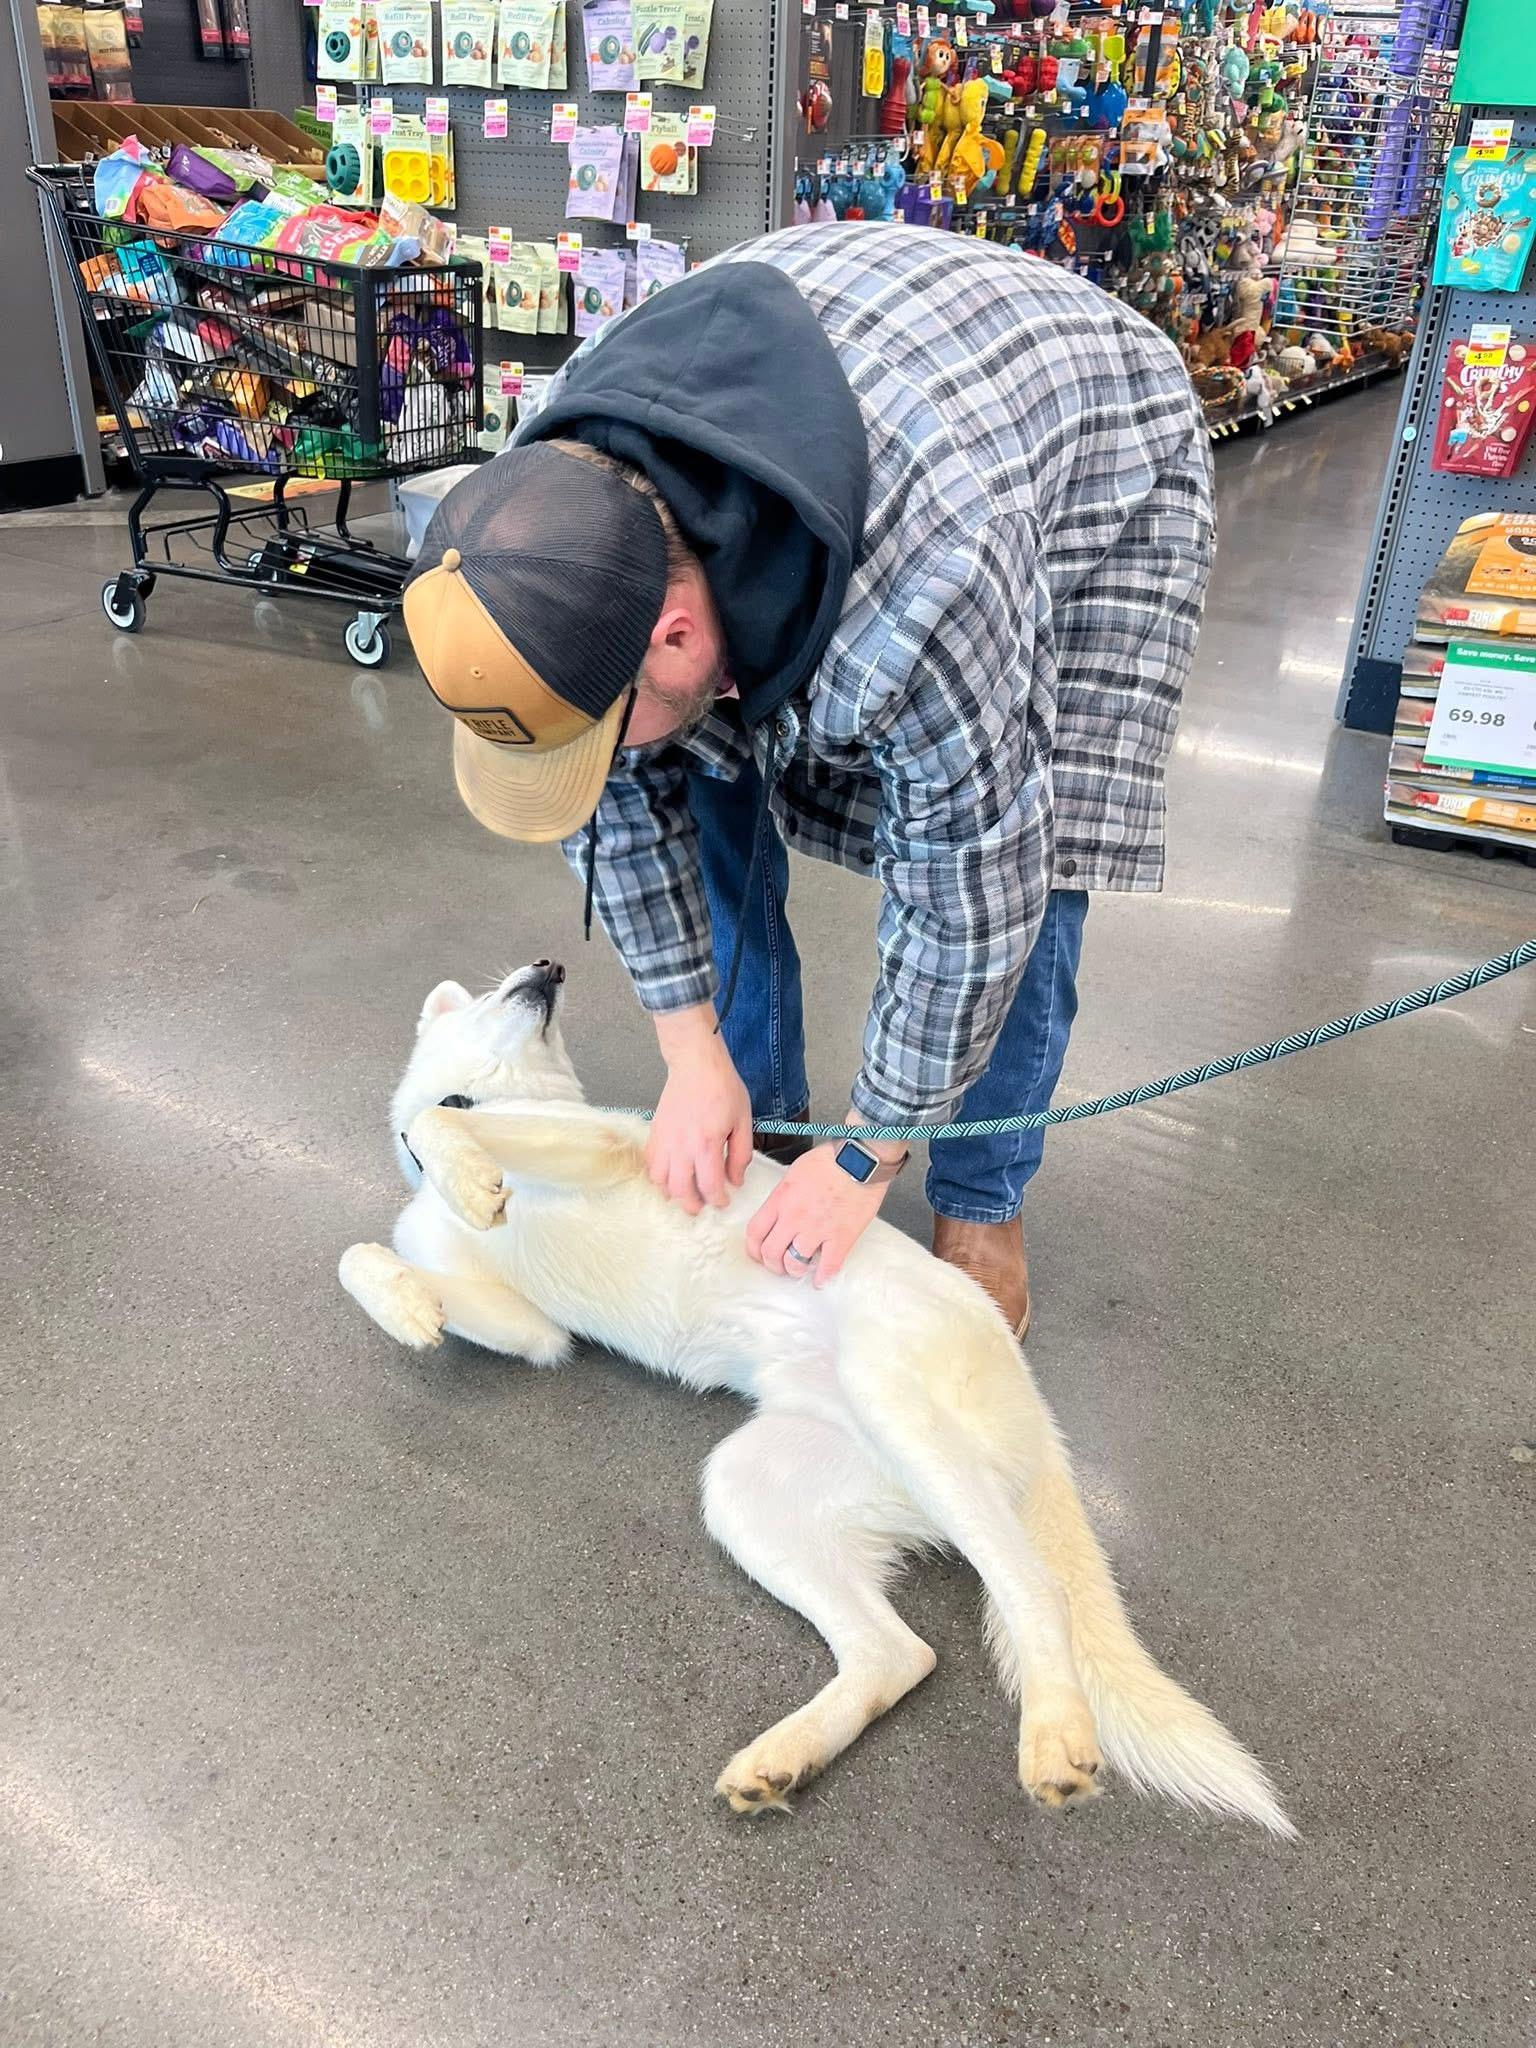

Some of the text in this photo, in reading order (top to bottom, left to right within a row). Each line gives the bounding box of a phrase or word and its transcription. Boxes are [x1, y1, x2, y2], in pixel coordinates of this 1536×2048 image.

[1456, 647, 1536, 664] Save money. Save
[471, 719, 511, 730] RIFLE
[1448, 708, 1506, 727] 69.98
